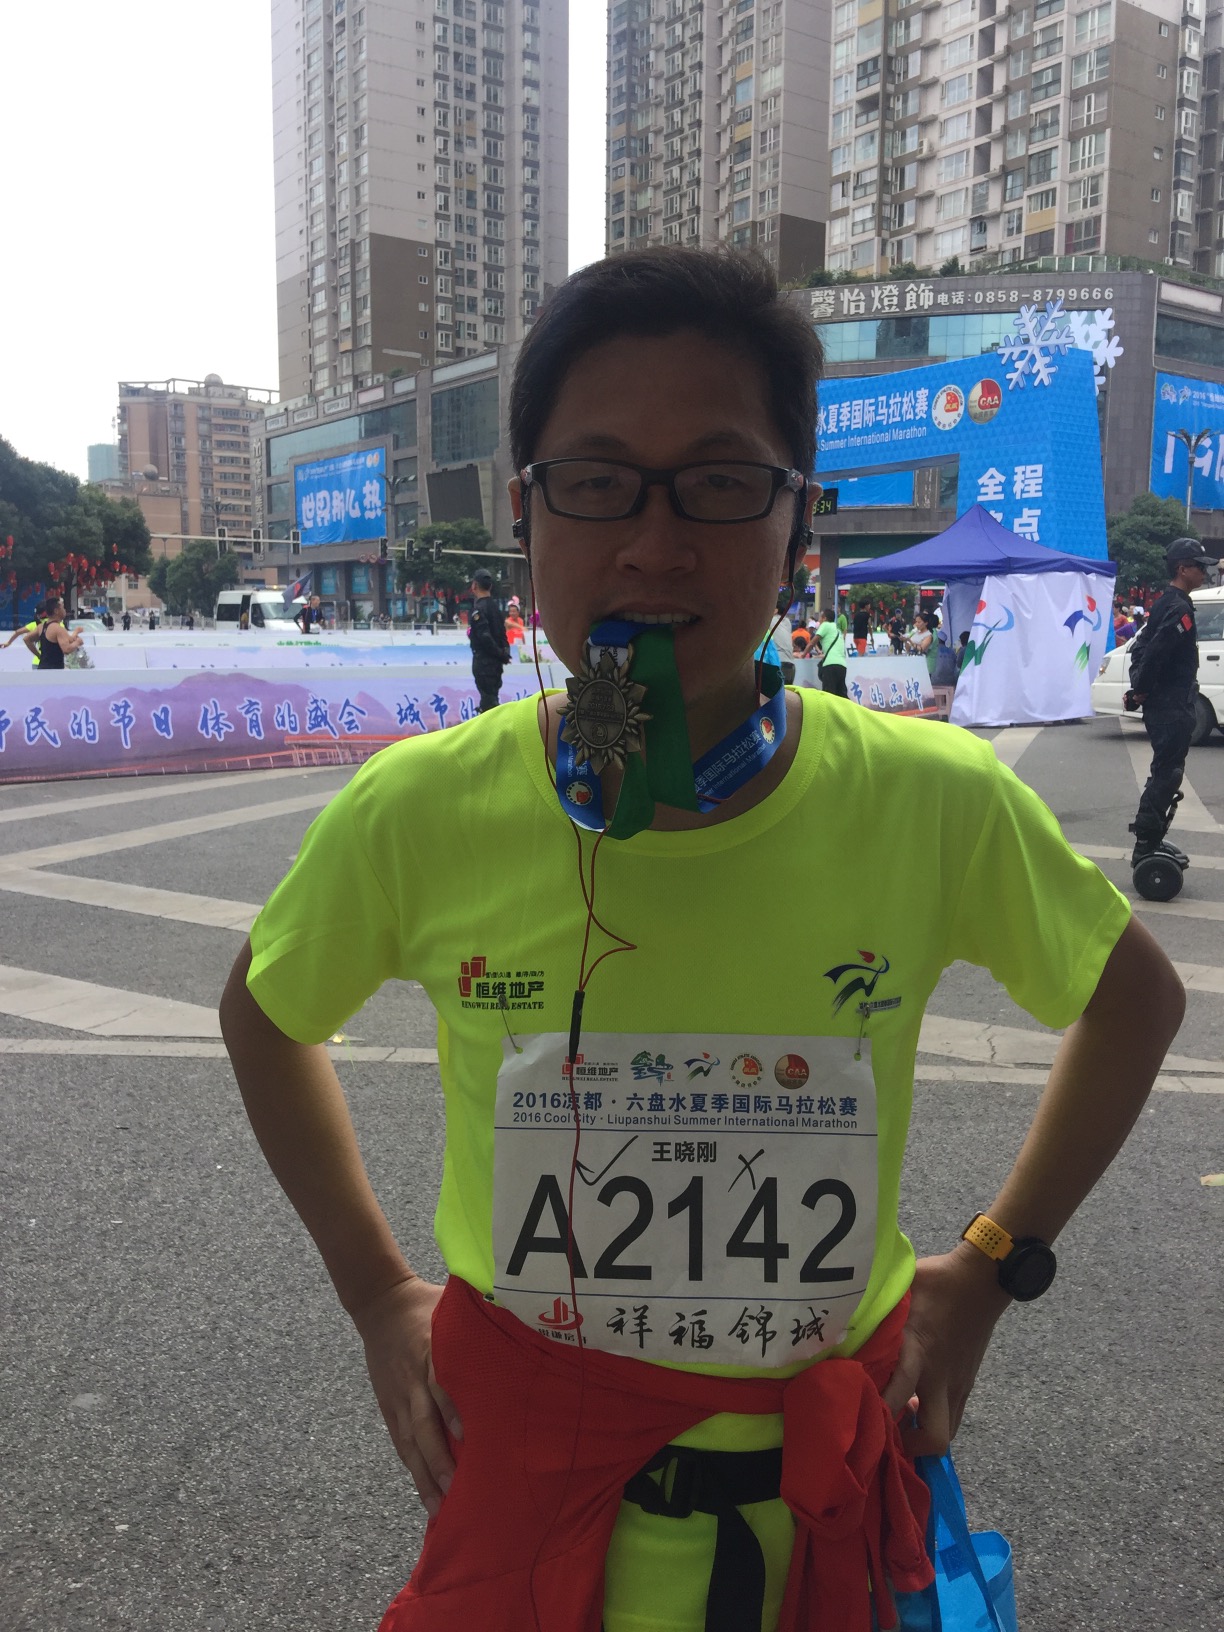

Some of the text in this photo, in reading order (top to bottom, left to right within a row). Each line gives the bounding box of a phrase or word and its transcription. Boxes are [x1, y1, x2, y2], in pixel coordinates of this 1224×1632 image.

[820, 425, 927, 452] Summer International Marathon
[977, 464, 1043, 502] 全程
[511, 1001, 545, 1010] ESTATE
[513, 1112, 541, 1123] 2016
[544, 1113, 571, 1123] Cool
[607, 1114, 671, 1127] Liupanshui
[673, 1115, 721, 1126] Summer
[724, 1116, 799, 1128] International
[801, 1117, 858, 1129] Marathon
[651, 1141, 717, 1163] 王晓刚
[506, 1174, 858, 1284] A2142
